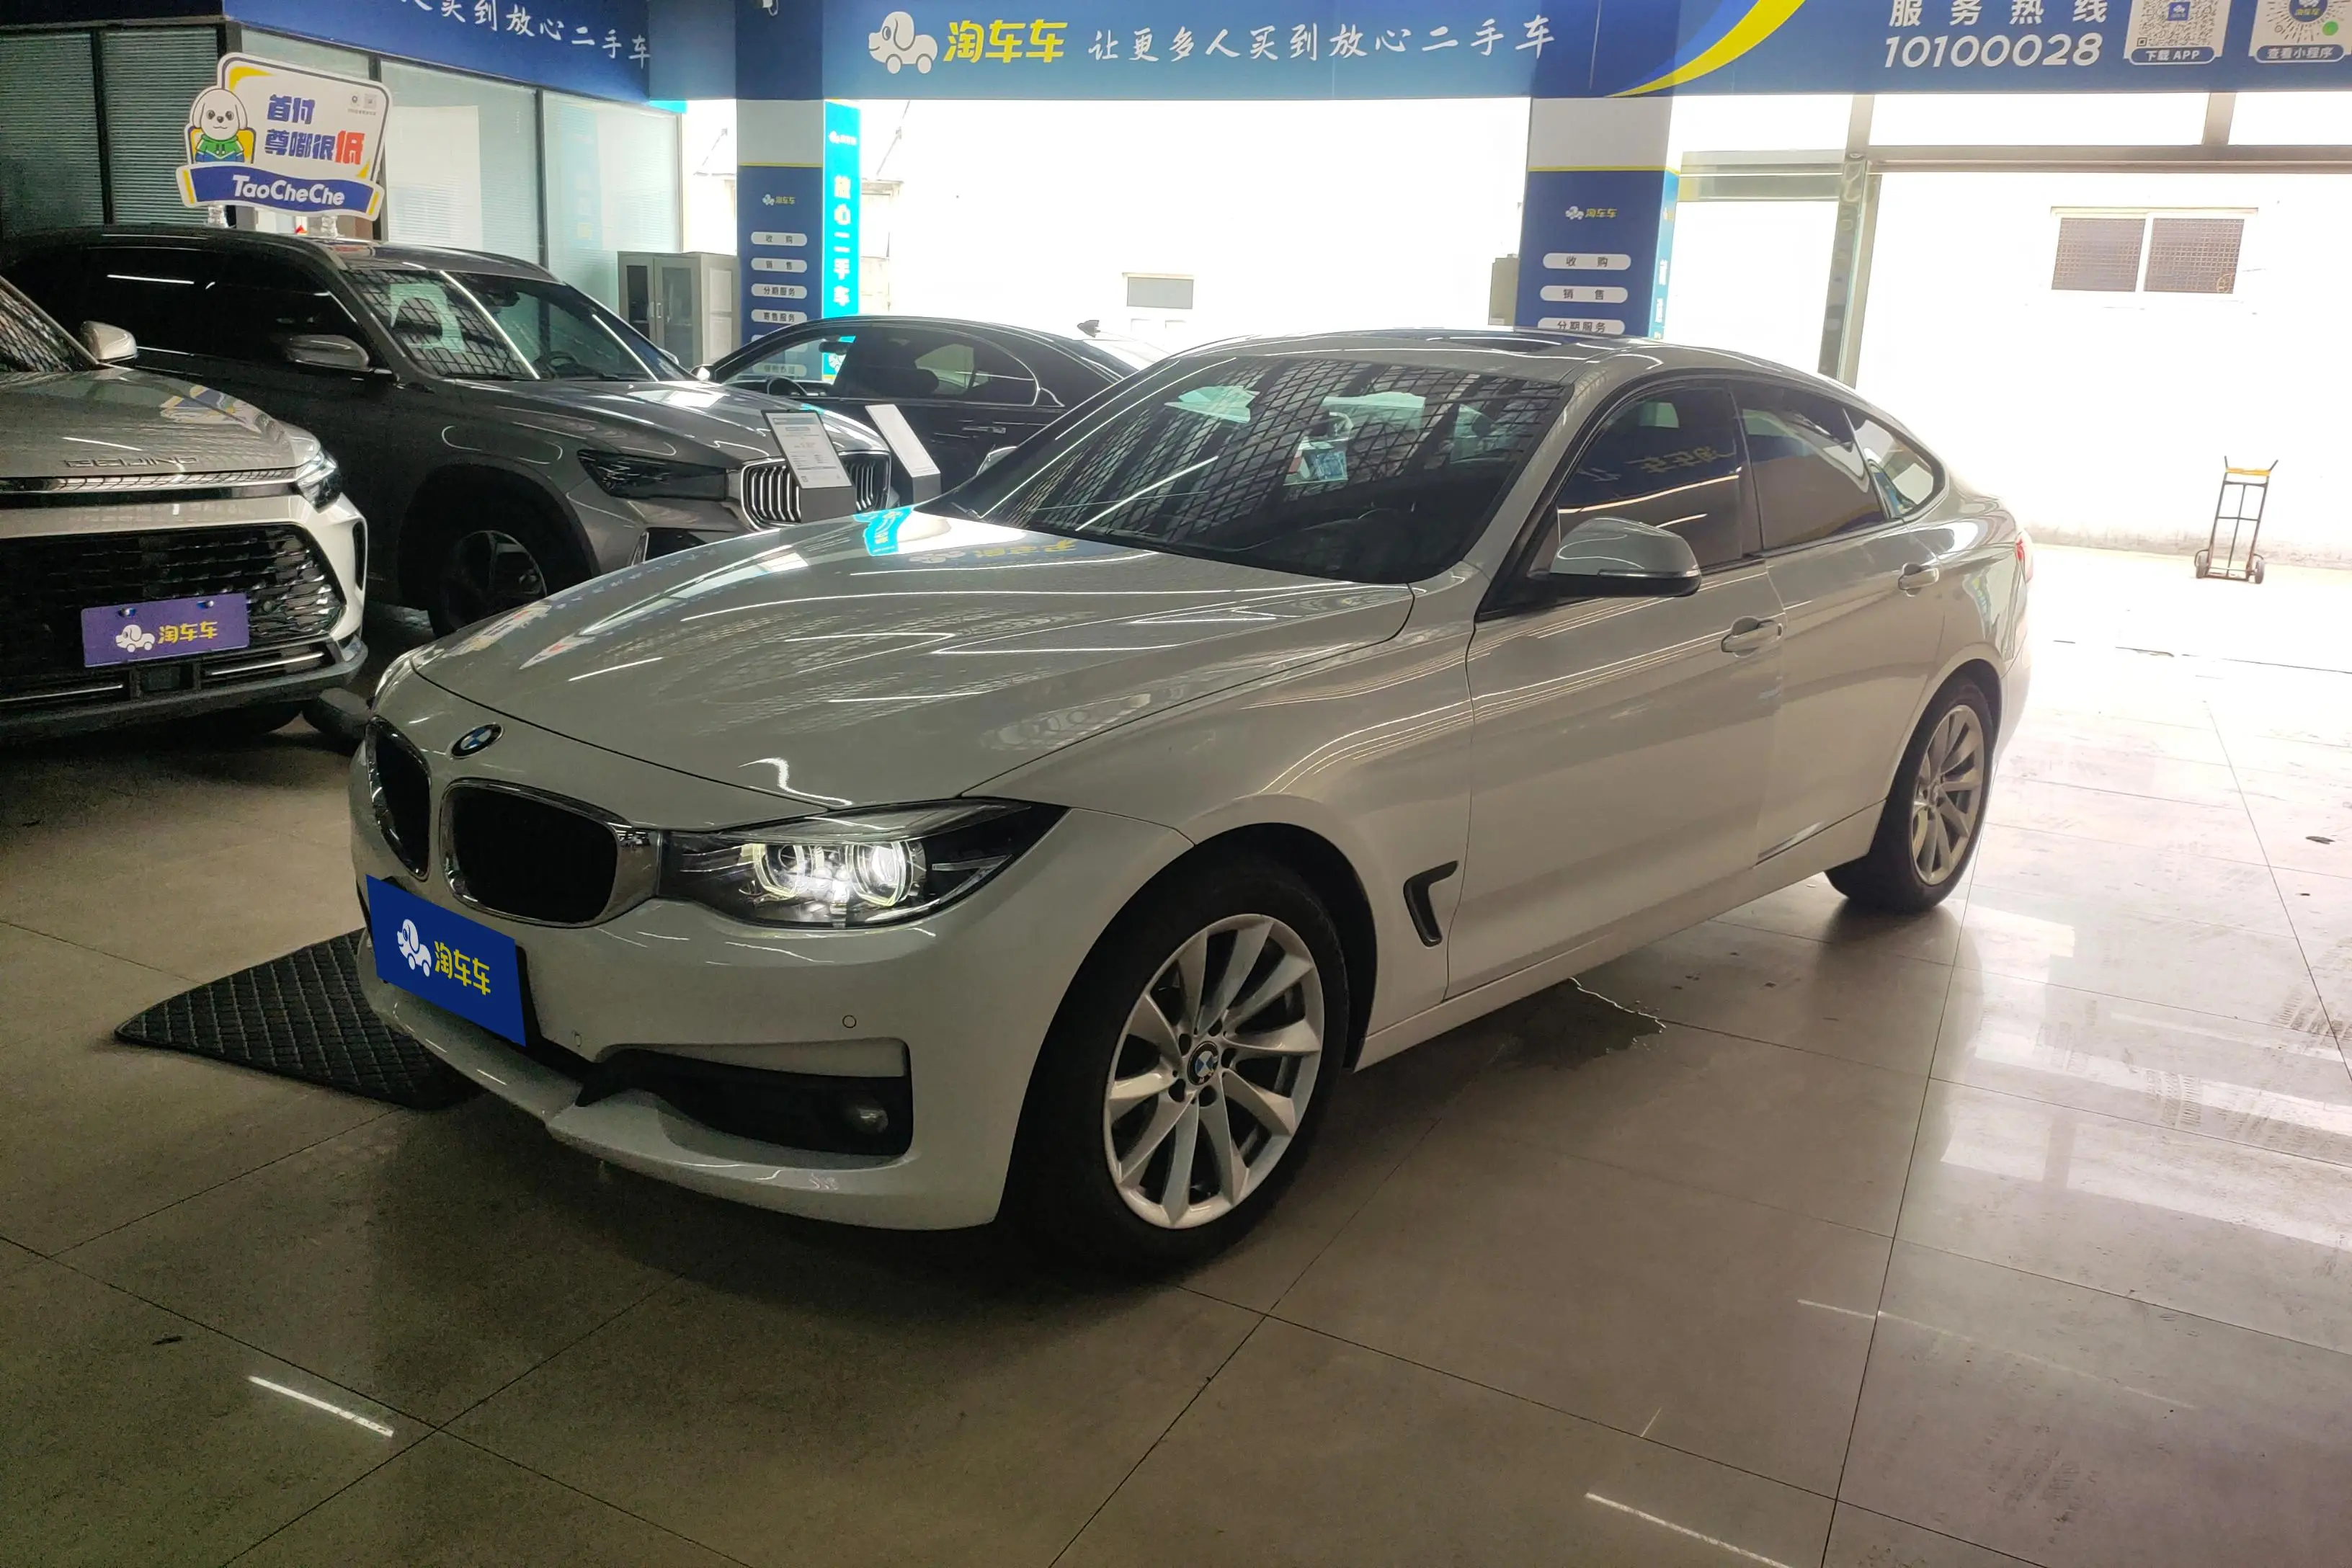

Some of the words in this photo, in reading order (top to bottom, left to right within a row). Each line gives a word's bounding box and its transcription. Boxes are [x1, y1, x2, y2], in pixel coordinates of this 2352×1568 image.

[1889, 0, 2108, 27] 服务热线
[944, 19, 1068, 64] 淘车车
[1087, 14, 1555, 62] 让更多人买到放心二手车
[1884, 33, 2103, 68] 10100028
[2145, 50, 2170, 61] 下载
[2173, 50, 2201, 61] APP
[267, 94, 316, 125] 首付
[264, 128, 365, 165] 尊嘟很低
[232, 174, 345, 206] TaoCheChe
[1585, 208, 1617, 218] 淘车车
[1565, 256, 1609, 267] 收购
[1562, 288, 1605, 300] 销售
[158, 620, 218, 644] 淘车车
